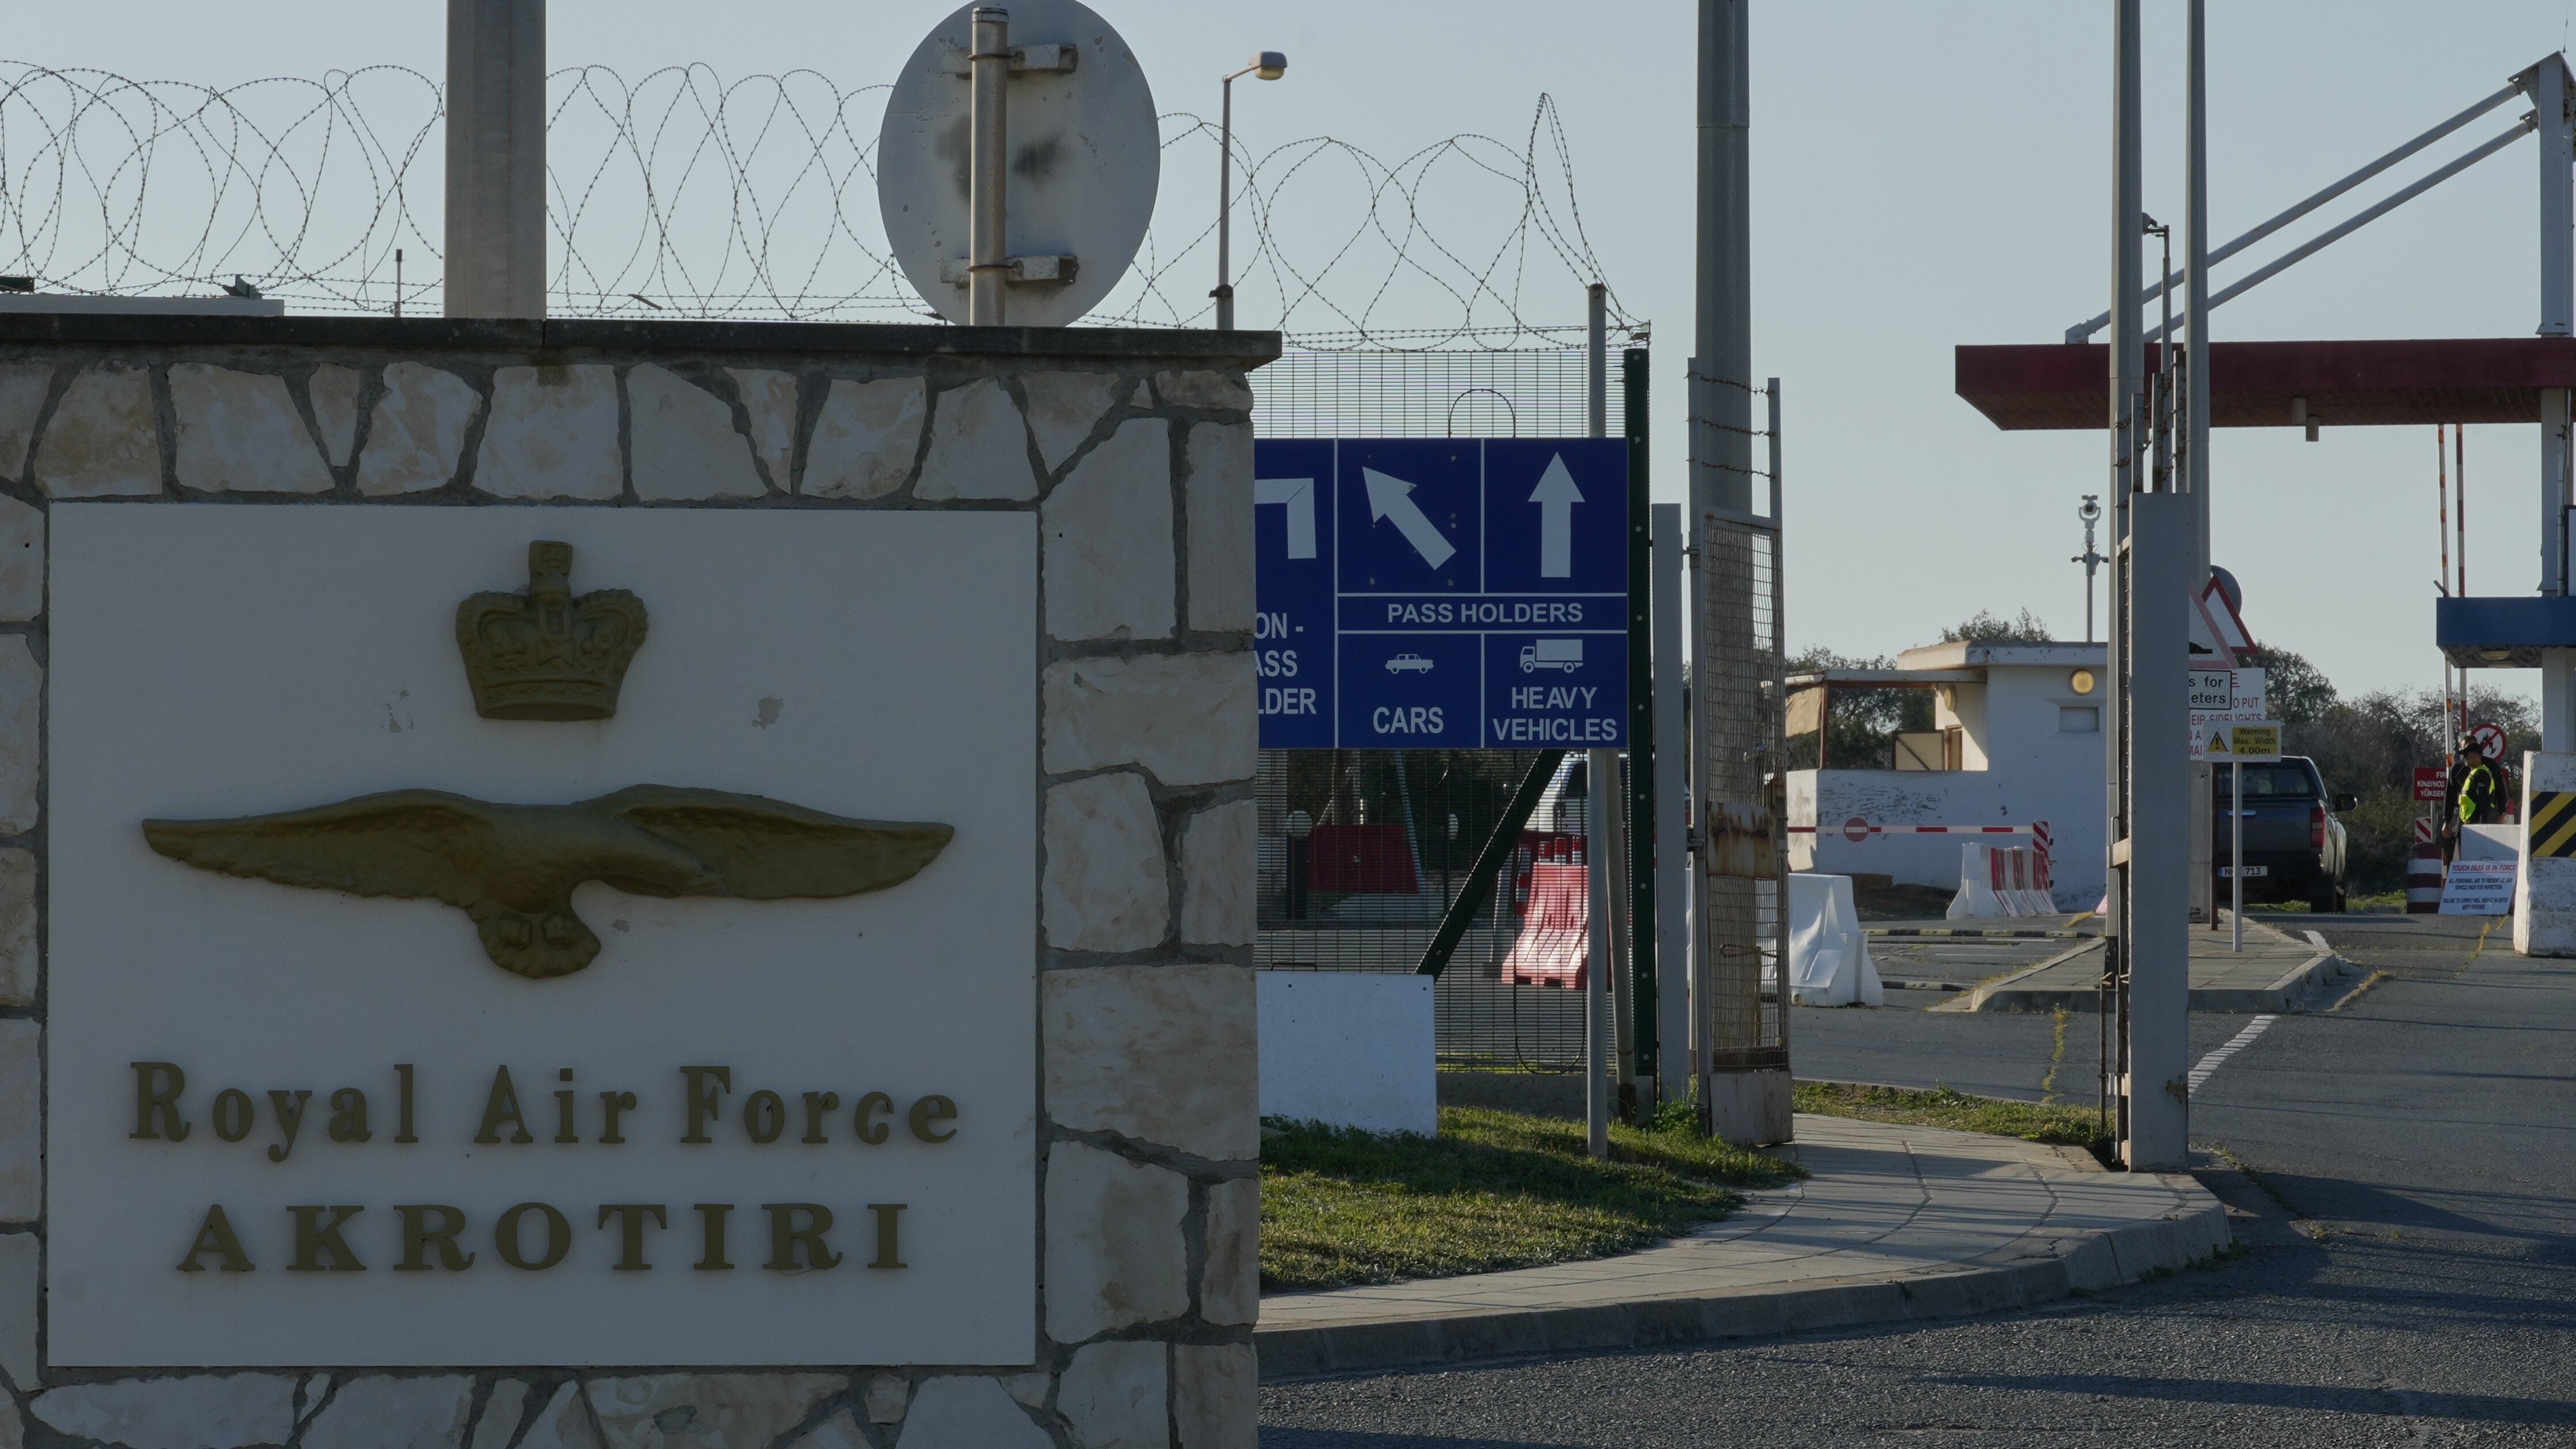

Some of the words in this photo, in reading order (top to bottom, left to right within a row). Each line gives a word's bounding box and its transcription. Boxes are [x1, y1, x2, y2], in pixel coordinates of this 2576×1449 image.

[1388, 603, 1453, 623] PASS
[1461, 603, 1583, 623] HOLDERS
[2204, 676, 2223, 687] for
[1258, 688, 1317, 714] DER
[1512, 687, 1597, 709] HEAVY
[2242, 697, 2260, 708] PUT
[1373, 707, 1444, 734] CARS
[1493, 718, 1617, 741] VEHICLES
[2239, 728, 2270, 736] Warning
[129, 1062, 421, 1162] Royal
[474, 1065, 637, 1144] Air
[680, 1065, 958, 1145] Force
[177, 1202, 908, 1272] AKROTIRI
